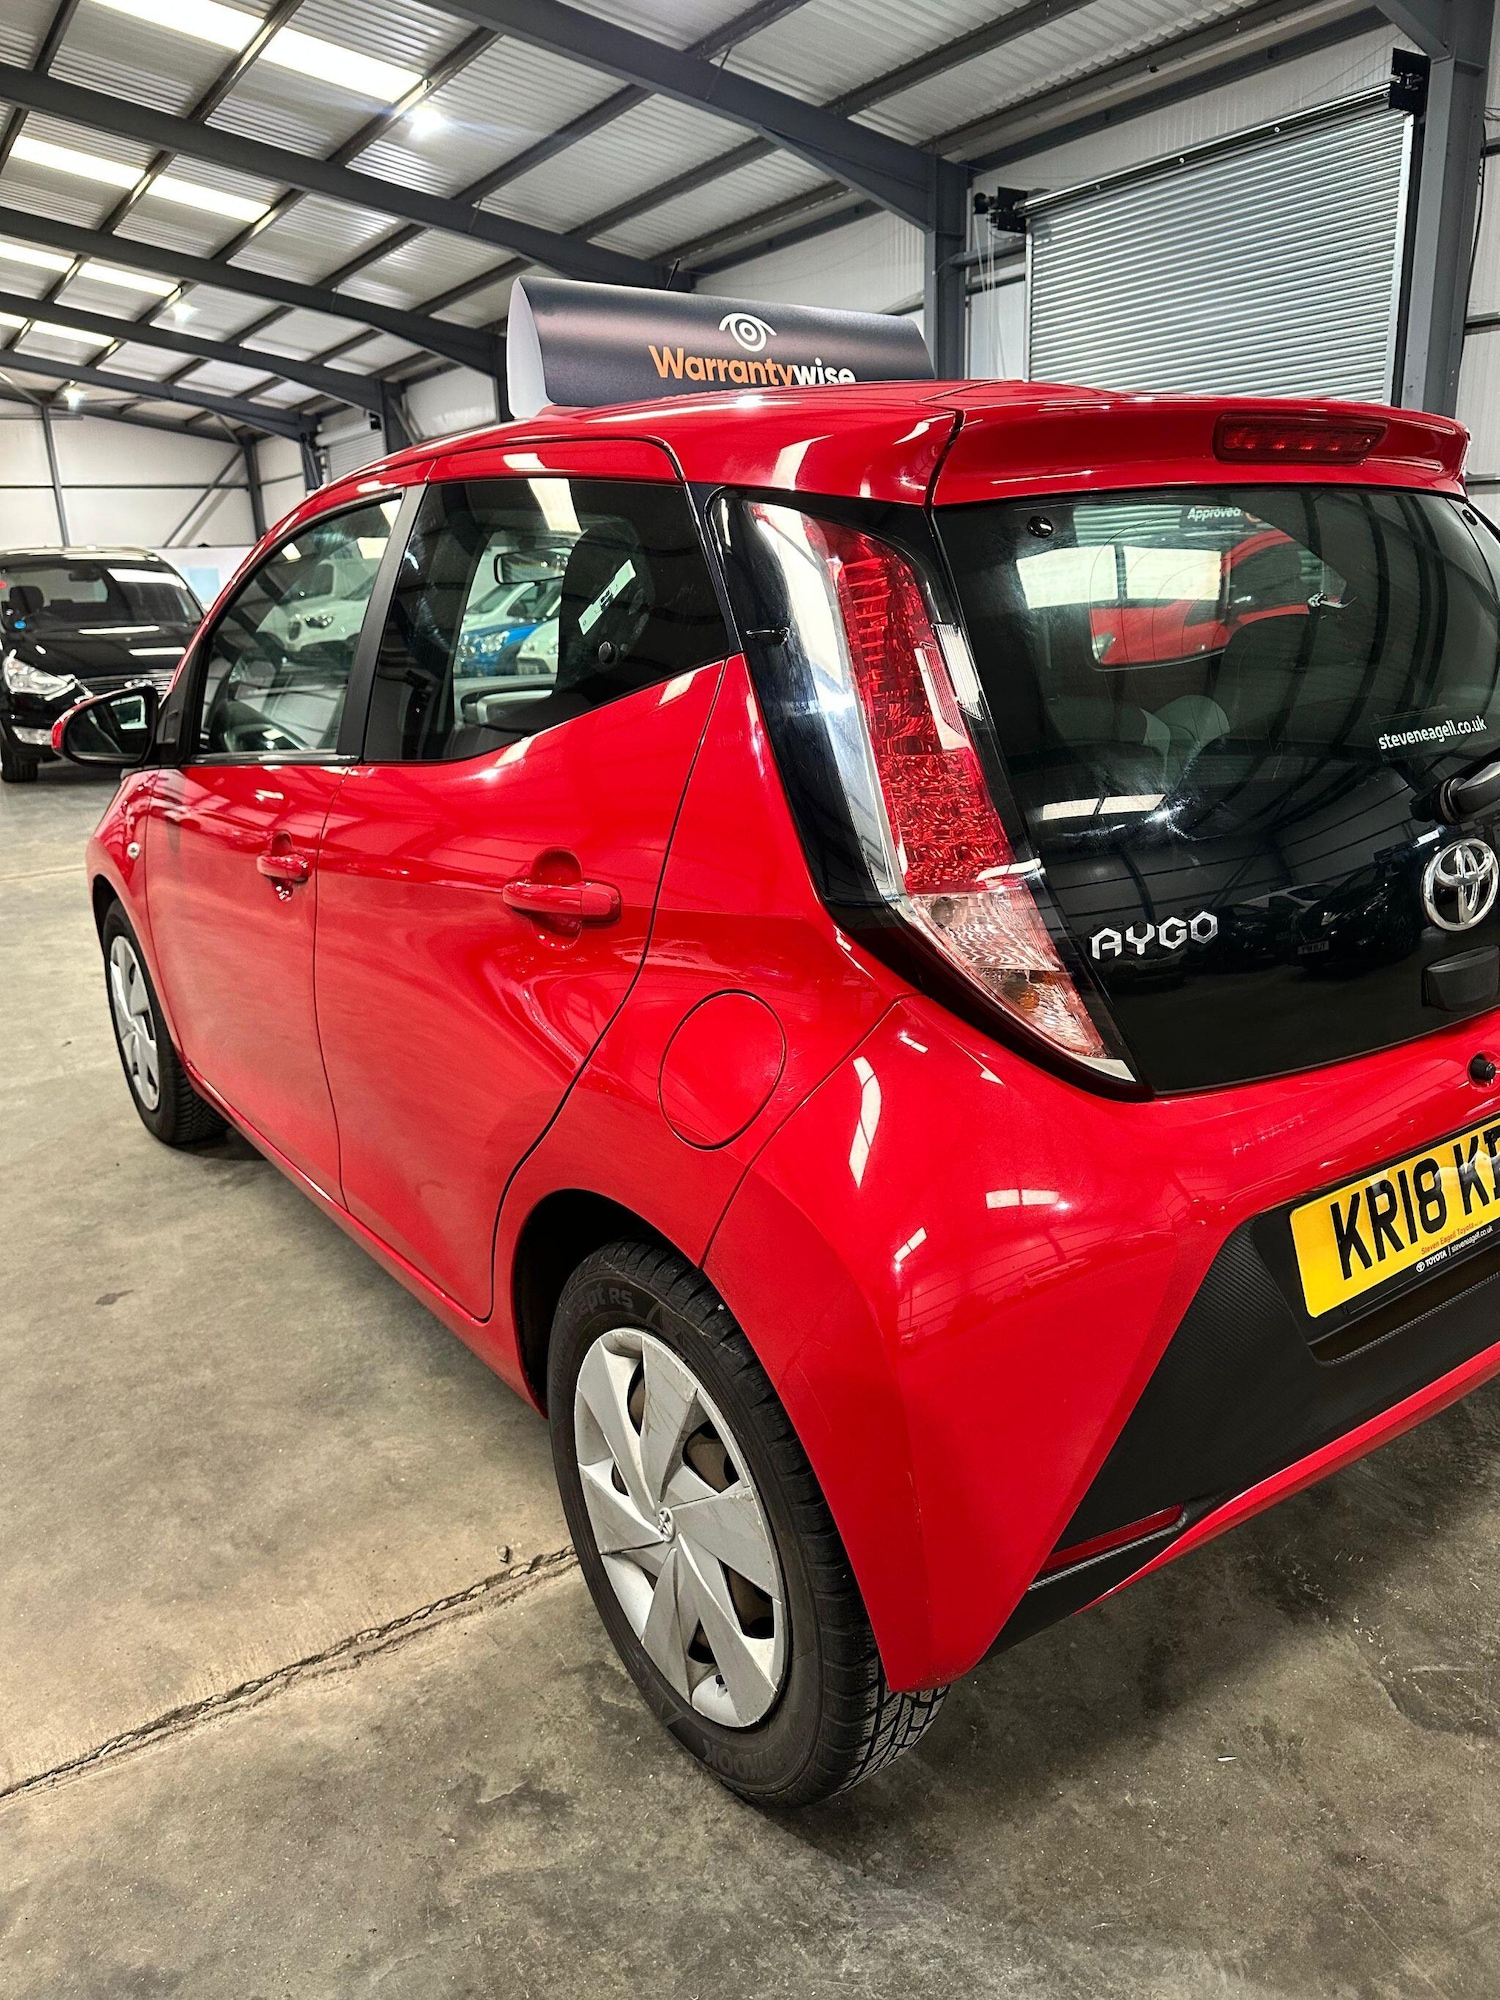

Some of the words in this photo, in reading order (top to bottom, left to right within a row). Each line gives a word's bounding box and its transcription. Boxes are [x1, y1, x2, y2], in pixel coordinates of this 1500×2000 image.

[648, 345, 856, 386] Warrantywise
[1378, 715, 1487, 750] steveneagell.co.uk
[1089, 910, 1218, 960] AYGO
[1330, 1157, 1447, 1281] KR18
[1421, 1241, 1440, 1255] Steven
[1457, 1222, 1475, 1236] Toyota
[1425, 1250, 1448, 1267] TOYOTA
